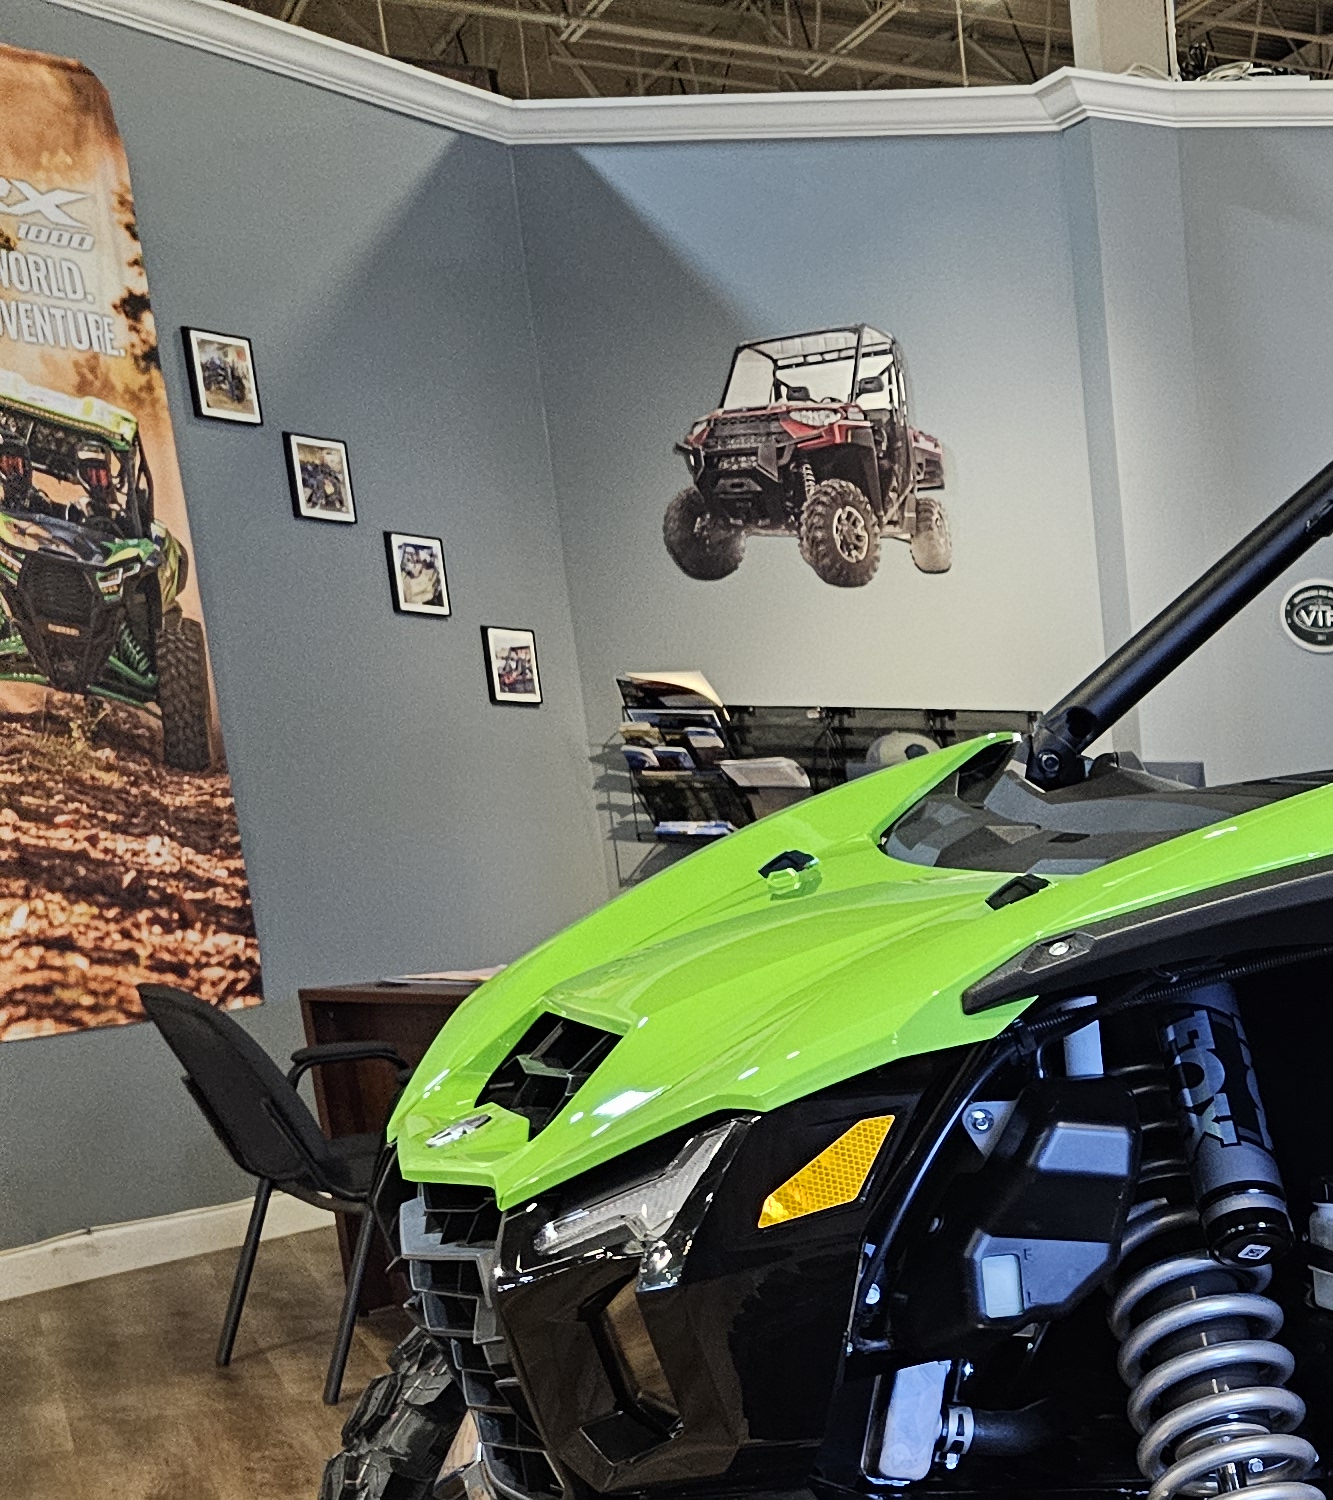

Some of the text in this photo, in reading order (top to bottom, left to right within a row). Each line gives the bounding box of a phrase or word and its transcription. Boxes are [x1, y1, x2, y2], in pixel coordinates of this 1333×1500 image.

[18, 221, 95, 250] 1000
[0, 300, 126, 357] VENTURE.
[1166, 1009, 1238, 1144] FOX
